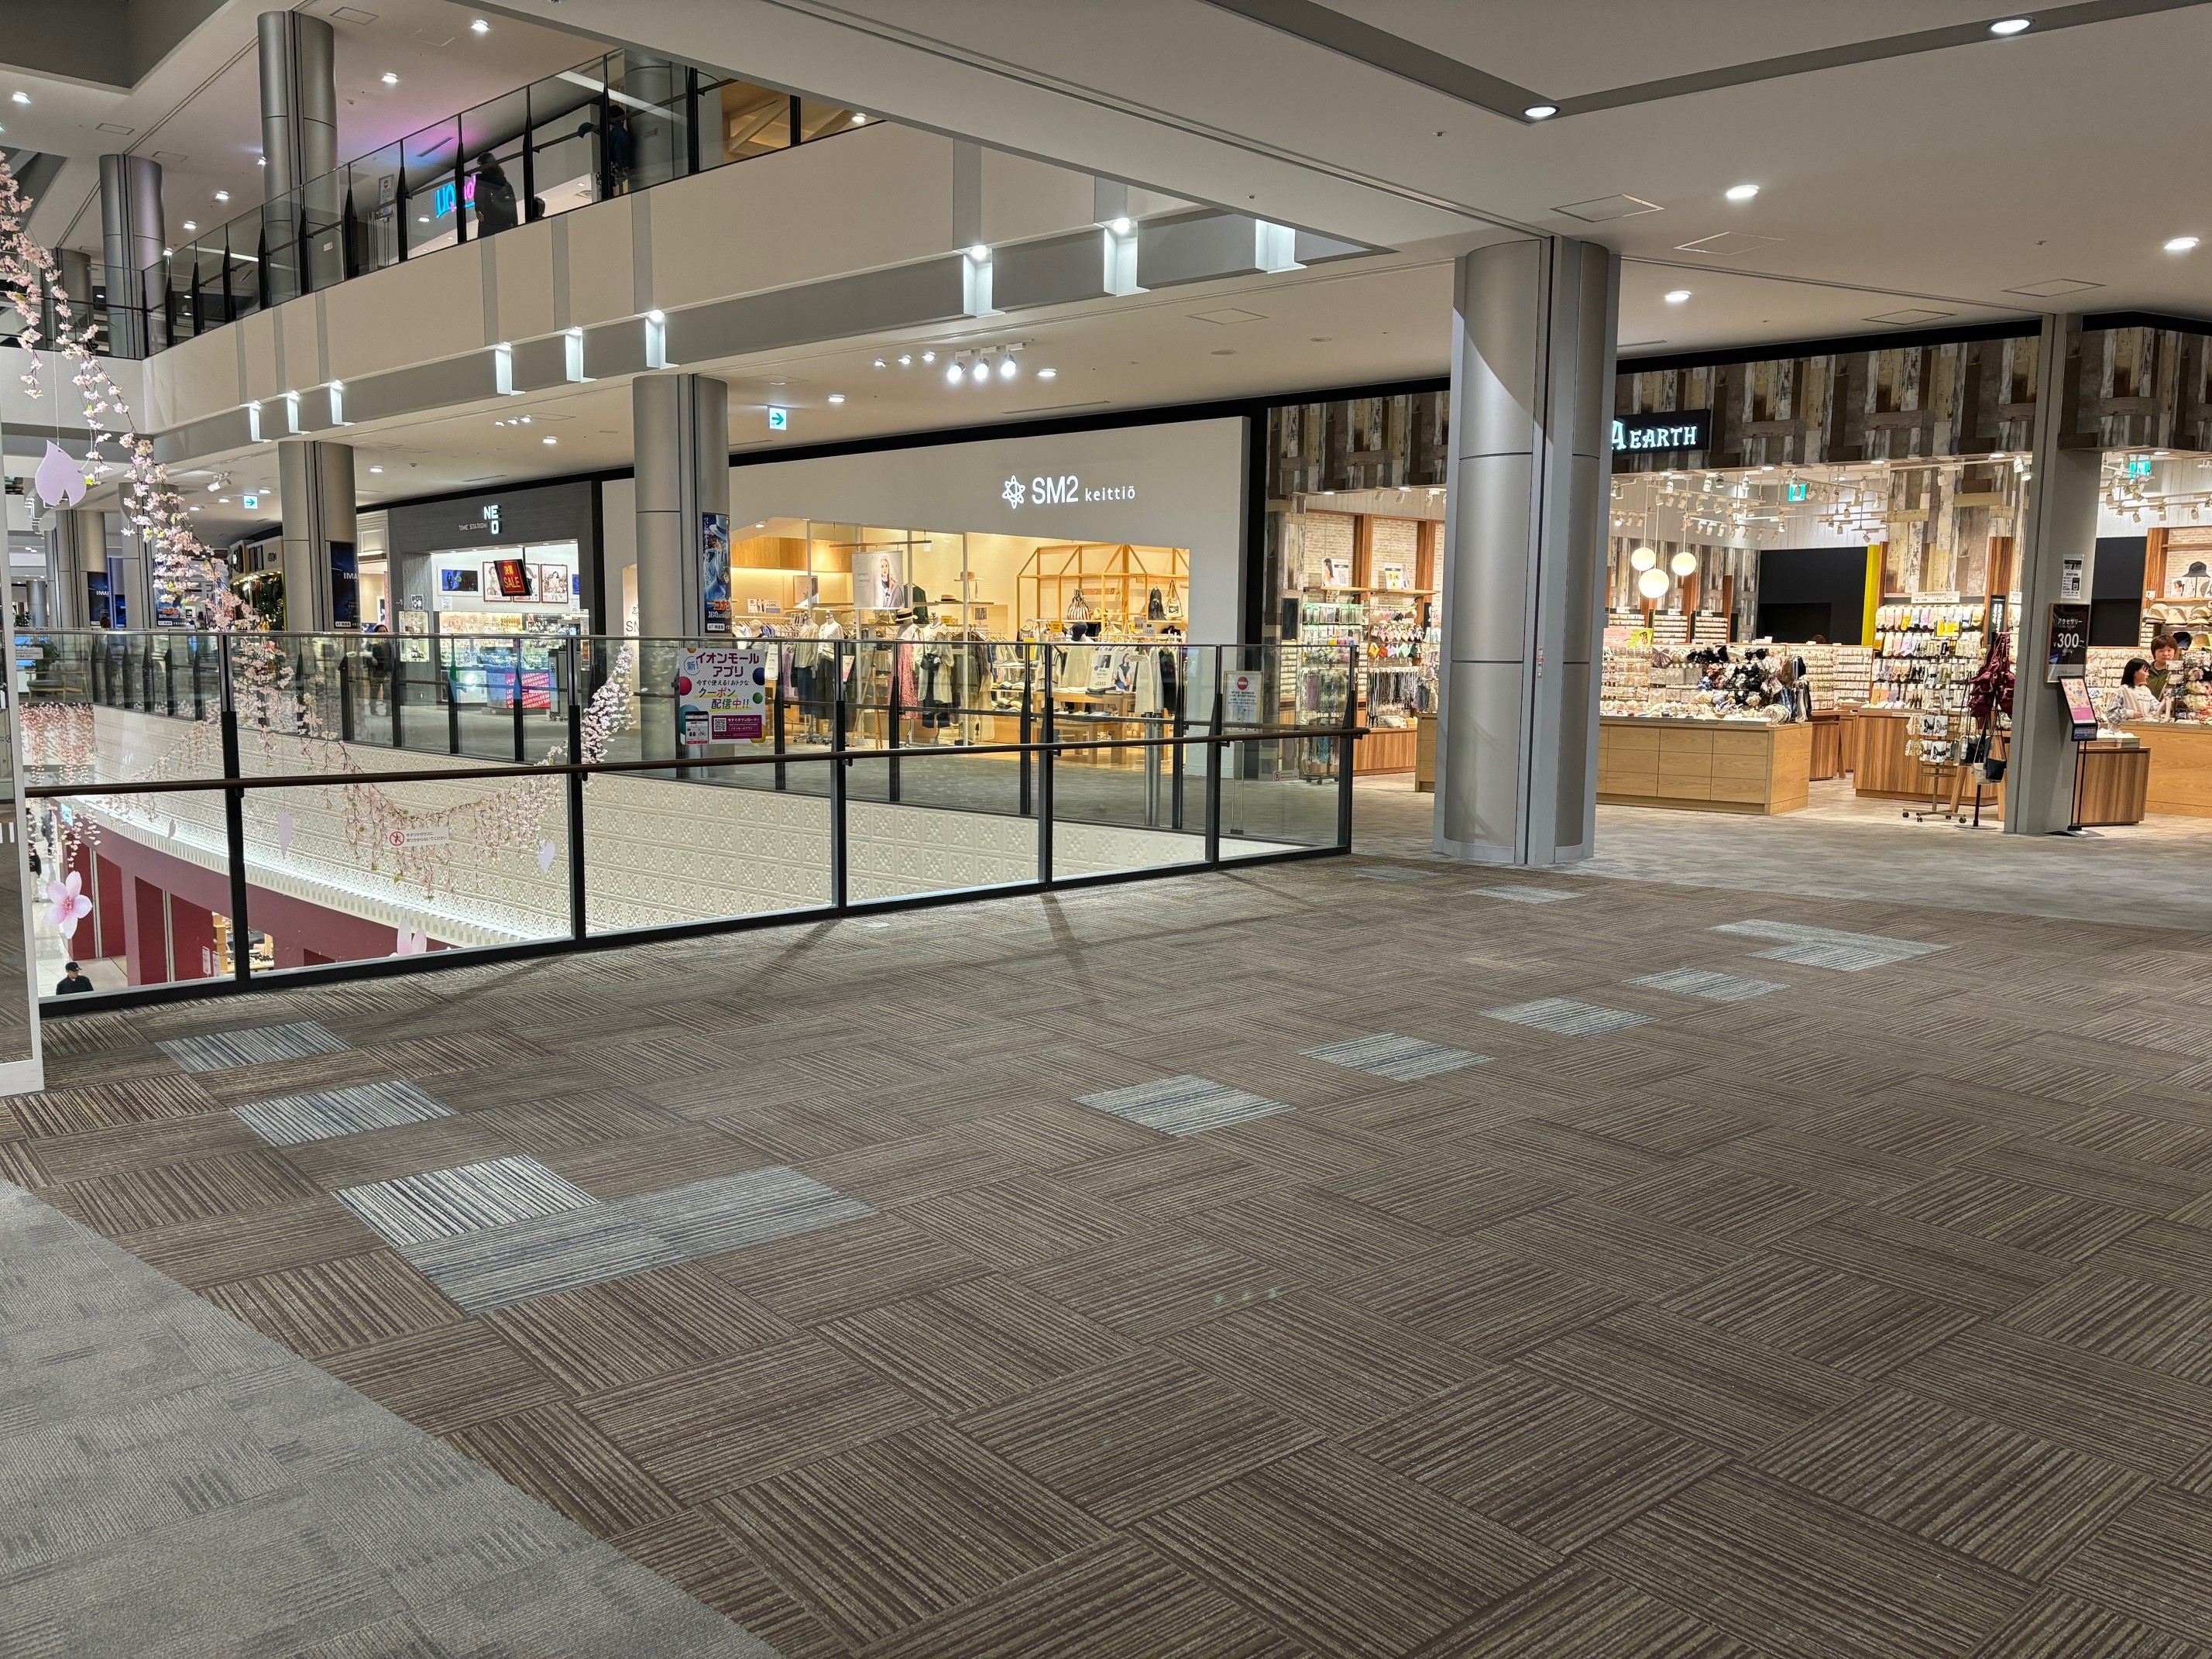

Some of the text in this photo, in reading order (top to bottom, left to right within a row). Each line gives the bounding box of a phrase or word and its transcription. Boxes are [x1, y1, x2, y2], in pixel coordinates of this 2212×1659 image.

[1630, 426, 1697, 448] EARTH
[1032, 475, 1136, 504] SM2 keittiö
[503, 576, 520, 589] SALE
[696, 652, 759, 664] イオンモール
[713, 666, 744, 678] アプリ
[699, 687, 736, 698] クーポン
[711, 698, 750, 709] 配信中!!
